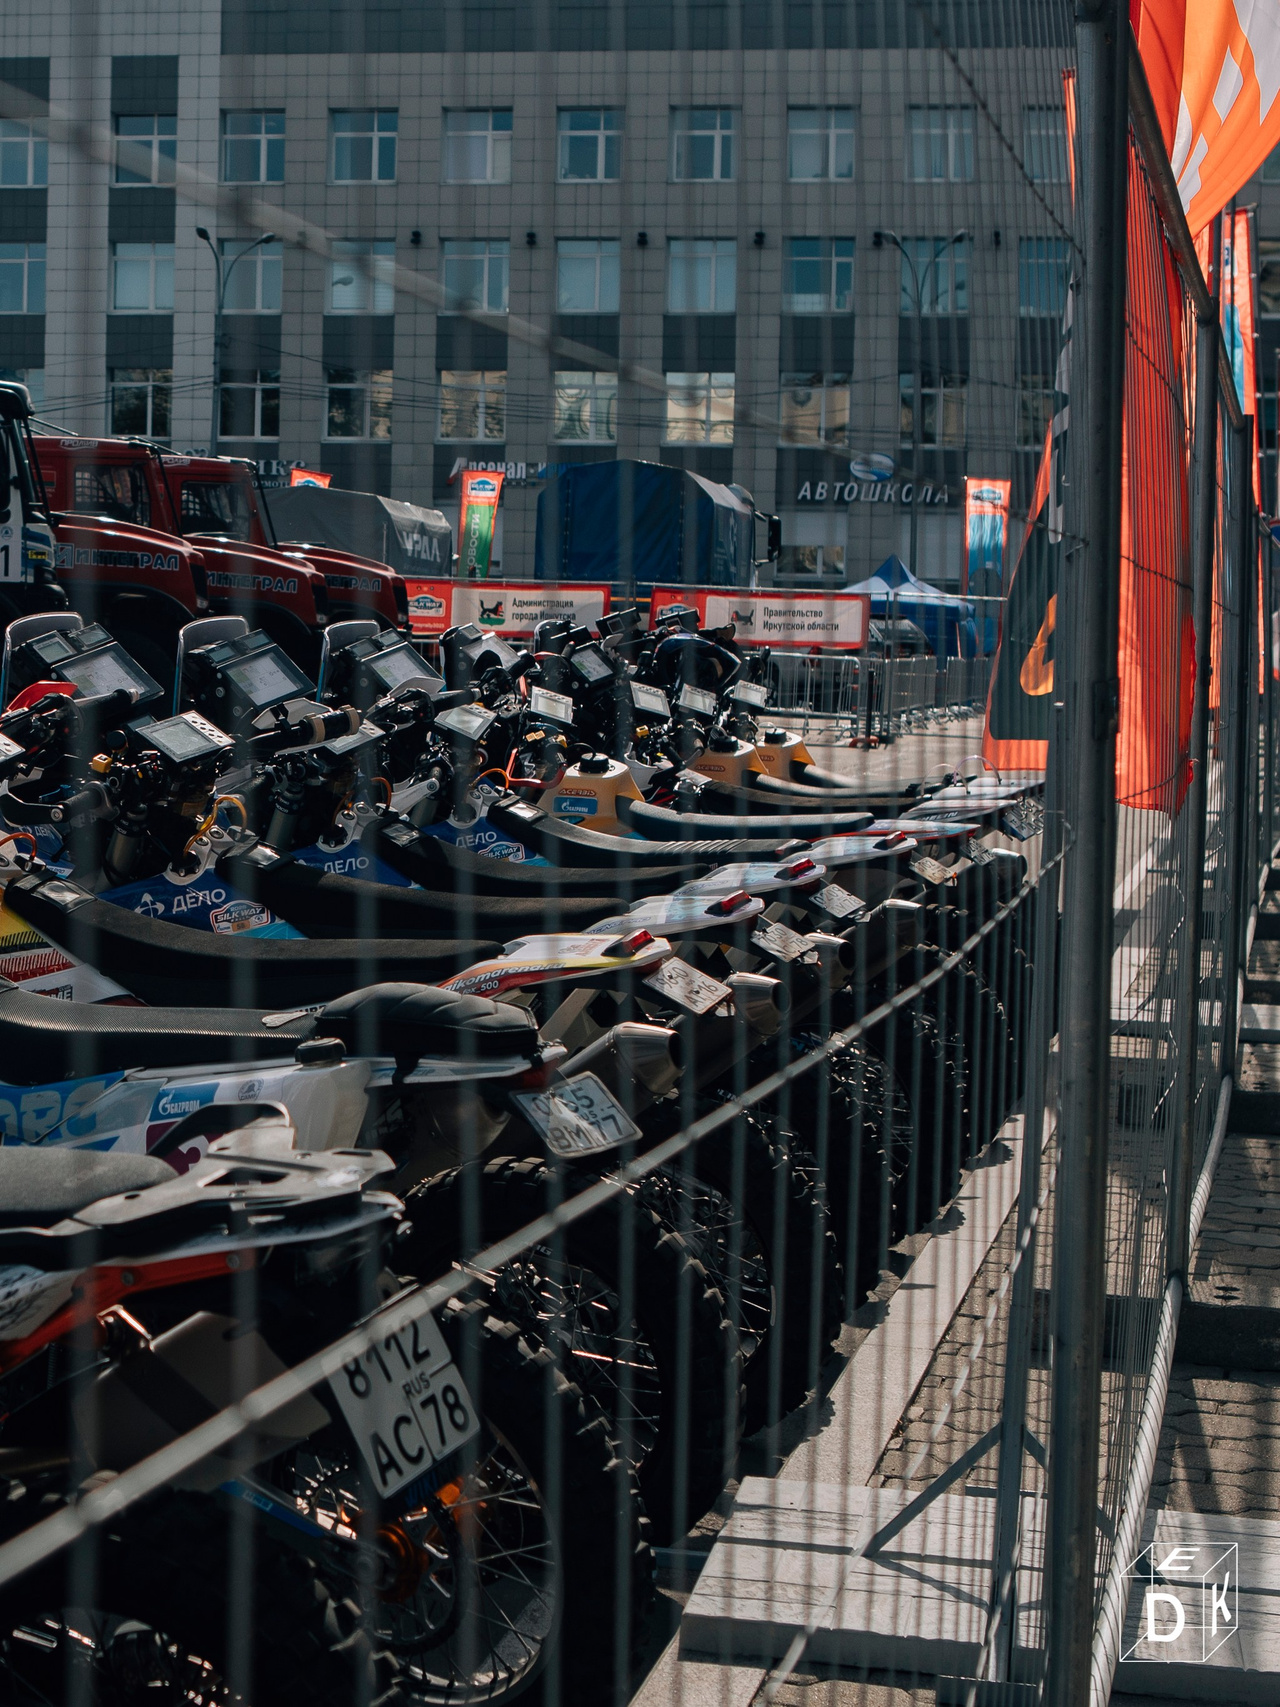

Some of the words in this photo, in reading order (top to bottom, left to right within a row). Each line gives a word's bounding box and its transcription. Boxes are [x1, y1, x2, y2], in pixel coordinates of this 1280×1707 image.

[797, 481, 950, 503] АВТОШКОЛА
[74, 547, 180, 572] ИНТЕГРАЛ
[512, 598, 575, 609] Администрация
[763, 607, 823, 619] Правительство
[512, 613, 539, 623] города
[763, 621, 806, 632] Иркутской
[807, 622, 840, 632] области
[455, 831, 497, 850] ДЕЛО
[323, 856, 370, 875] ДЕЛО
[172, 888, 227, 915] ДЕЛО
[217, 911, 240, 923] SILK
[241, 907, 263, 916] WAY
[402, 1371, 431, 1399] RUS
[420, 1384, 469, 1447] 78
